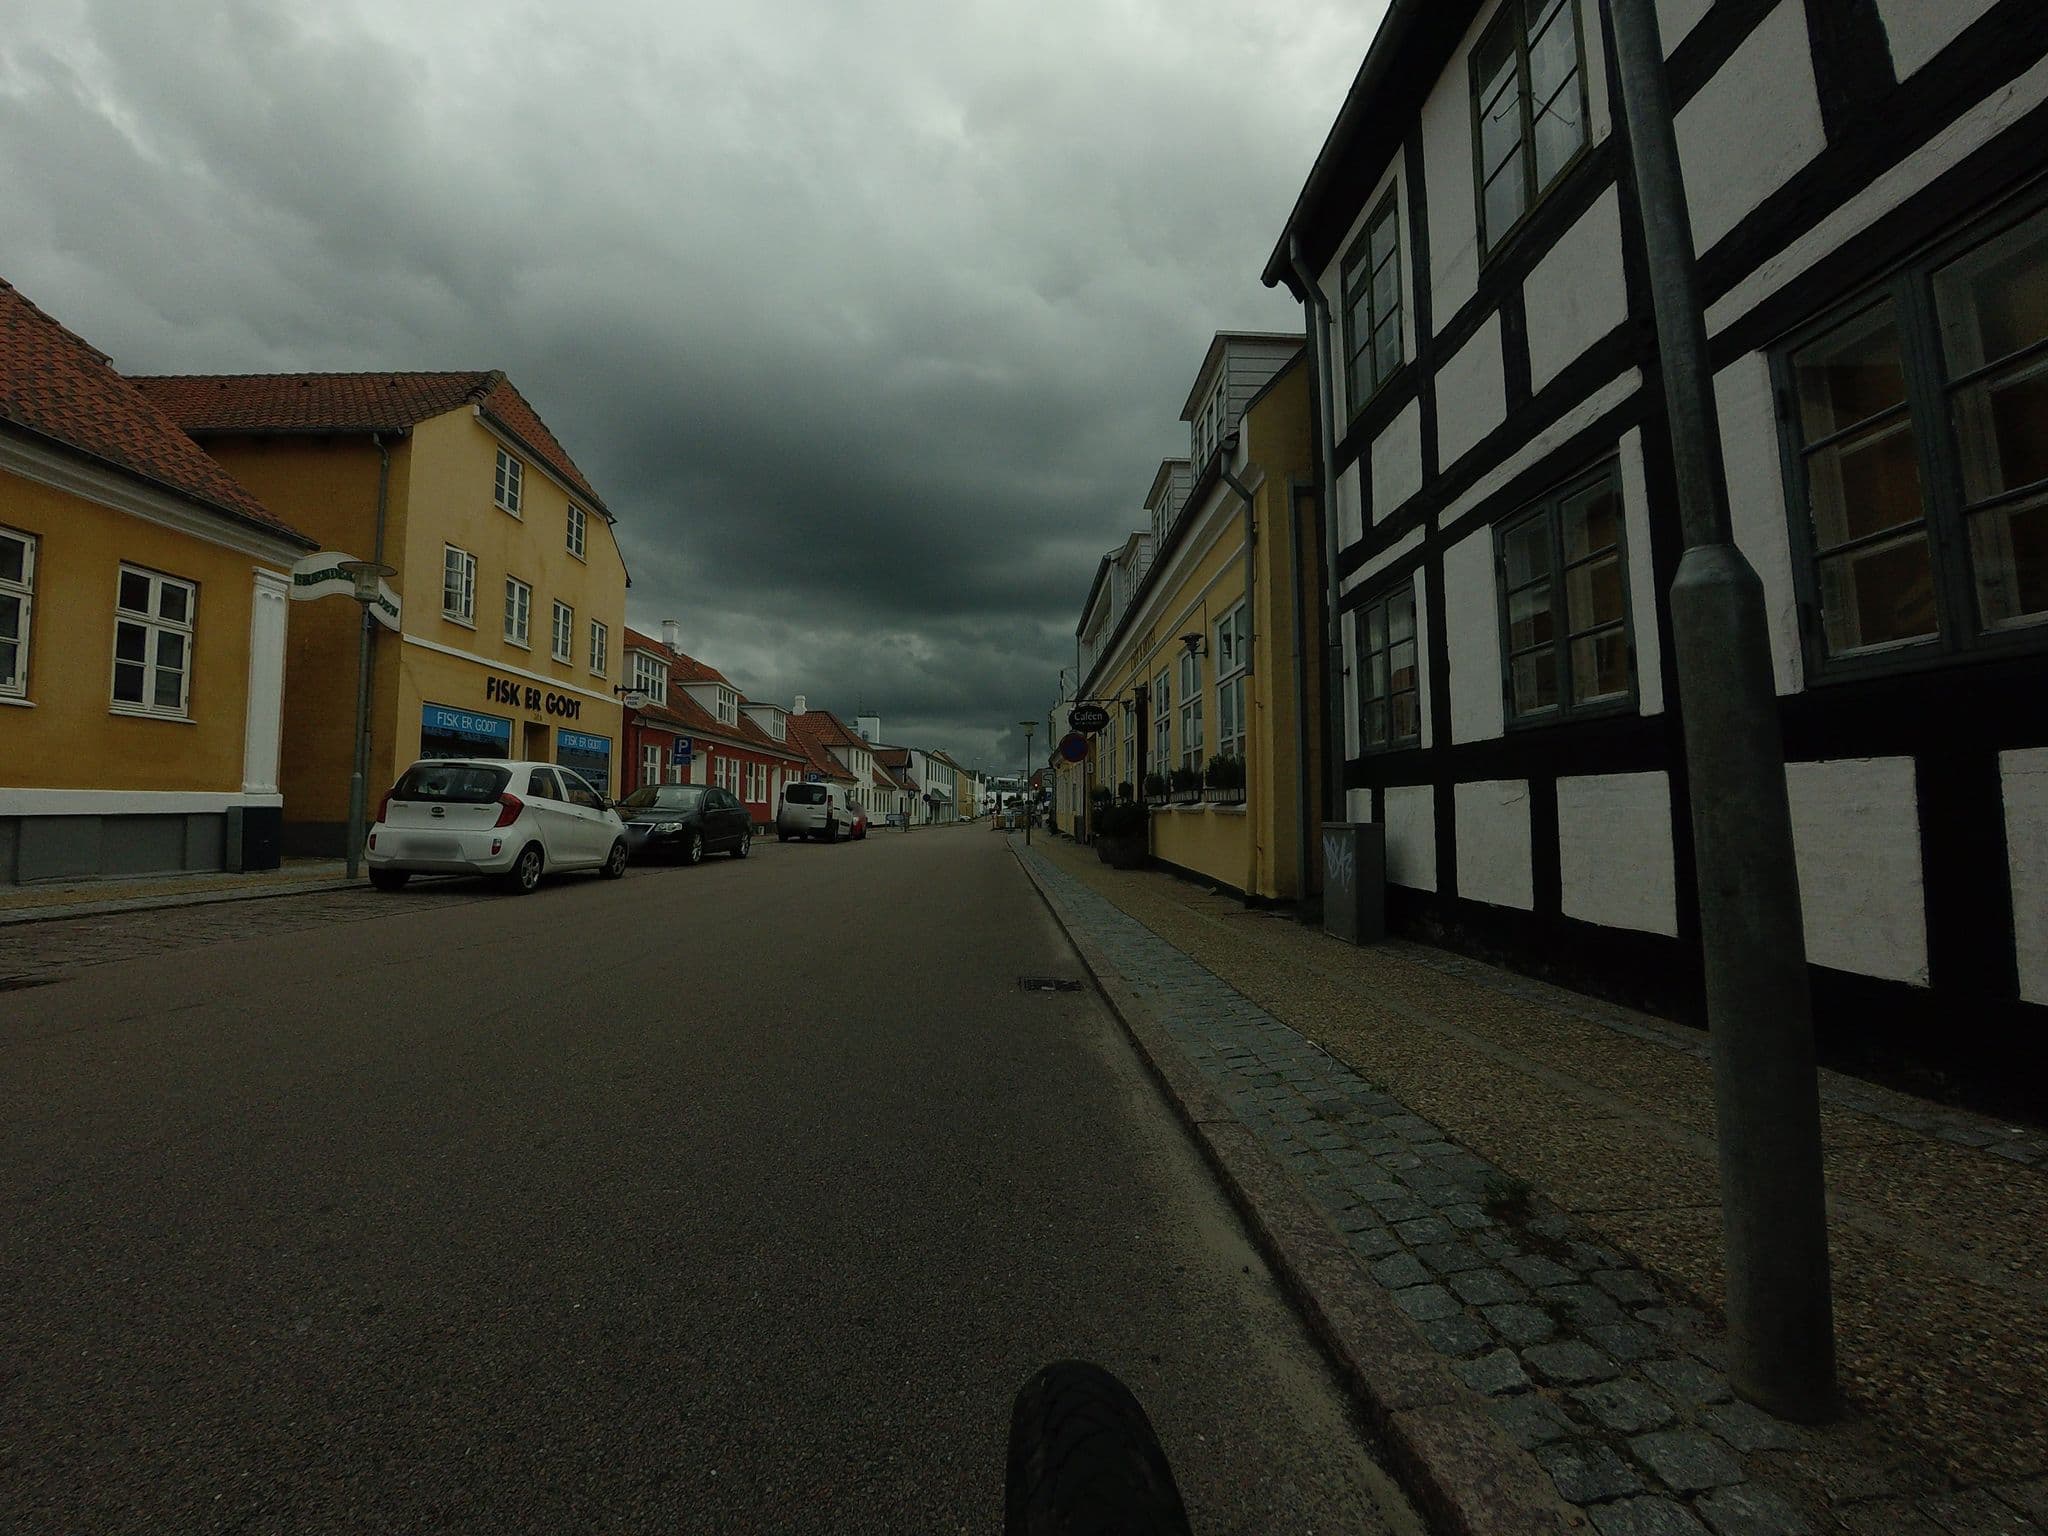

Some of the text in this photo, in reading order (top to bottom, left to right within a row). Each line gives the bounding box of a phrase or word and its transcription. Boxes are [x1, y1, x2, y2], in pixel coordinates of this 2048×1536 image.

[487, 676, 581, 720] FISK ER GODT
[437, 711, 498, 733] FISK ER GODT
[564, 734, 602, 750] FISK ER GODT
[678, 739, 688, 753] P
[810, 774, 817, 782] P
